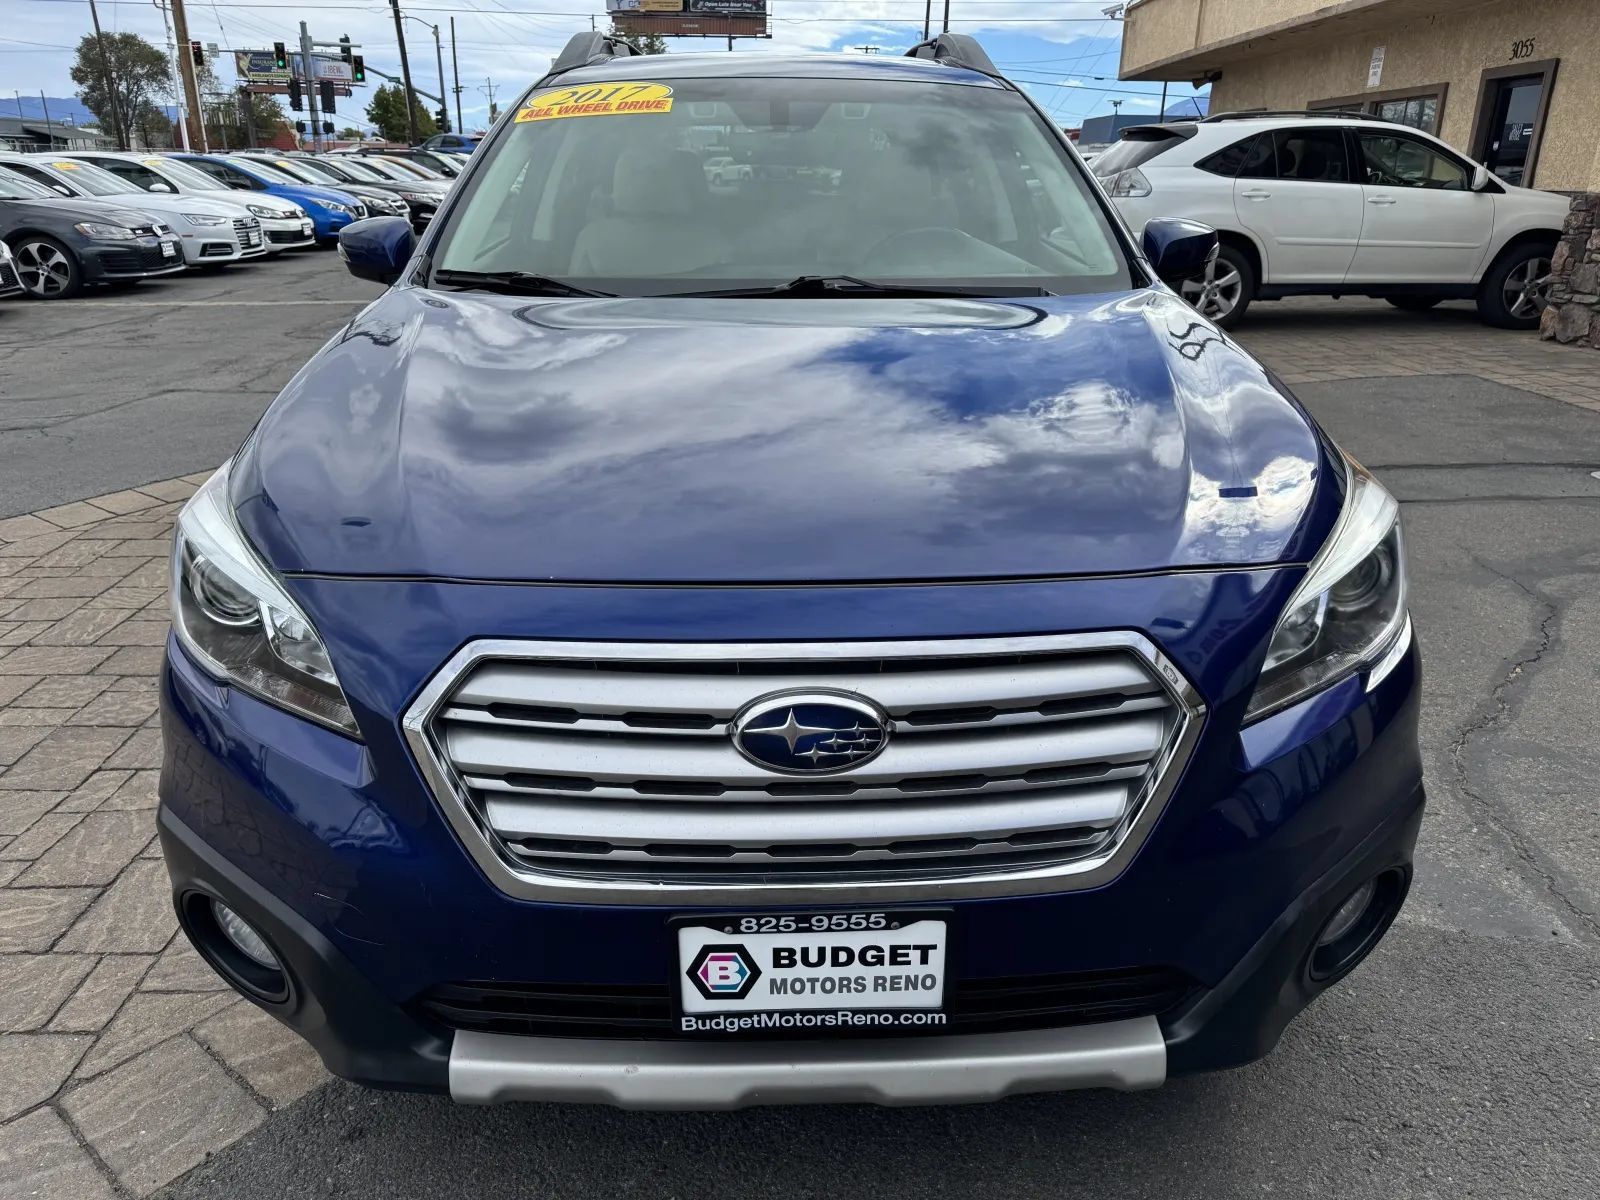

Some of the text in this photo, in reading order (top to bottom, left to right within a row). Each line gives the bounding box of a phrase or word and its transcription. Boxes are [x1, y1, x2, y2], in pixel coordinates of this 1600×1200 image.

[1509, 37, 1536, 60] 3055
[552, 86, 652, 106] 2017
[520, 99, 668, 120] ALL WHEEL DRIVE
[739, 913, 887, 933] 825-9555
[771, 943, 938, 969] BUDGET
[769, 973, 937, 995] MOTORS RENO
[681, 1011, 947, 1032] BudgetMotorsReno.com
